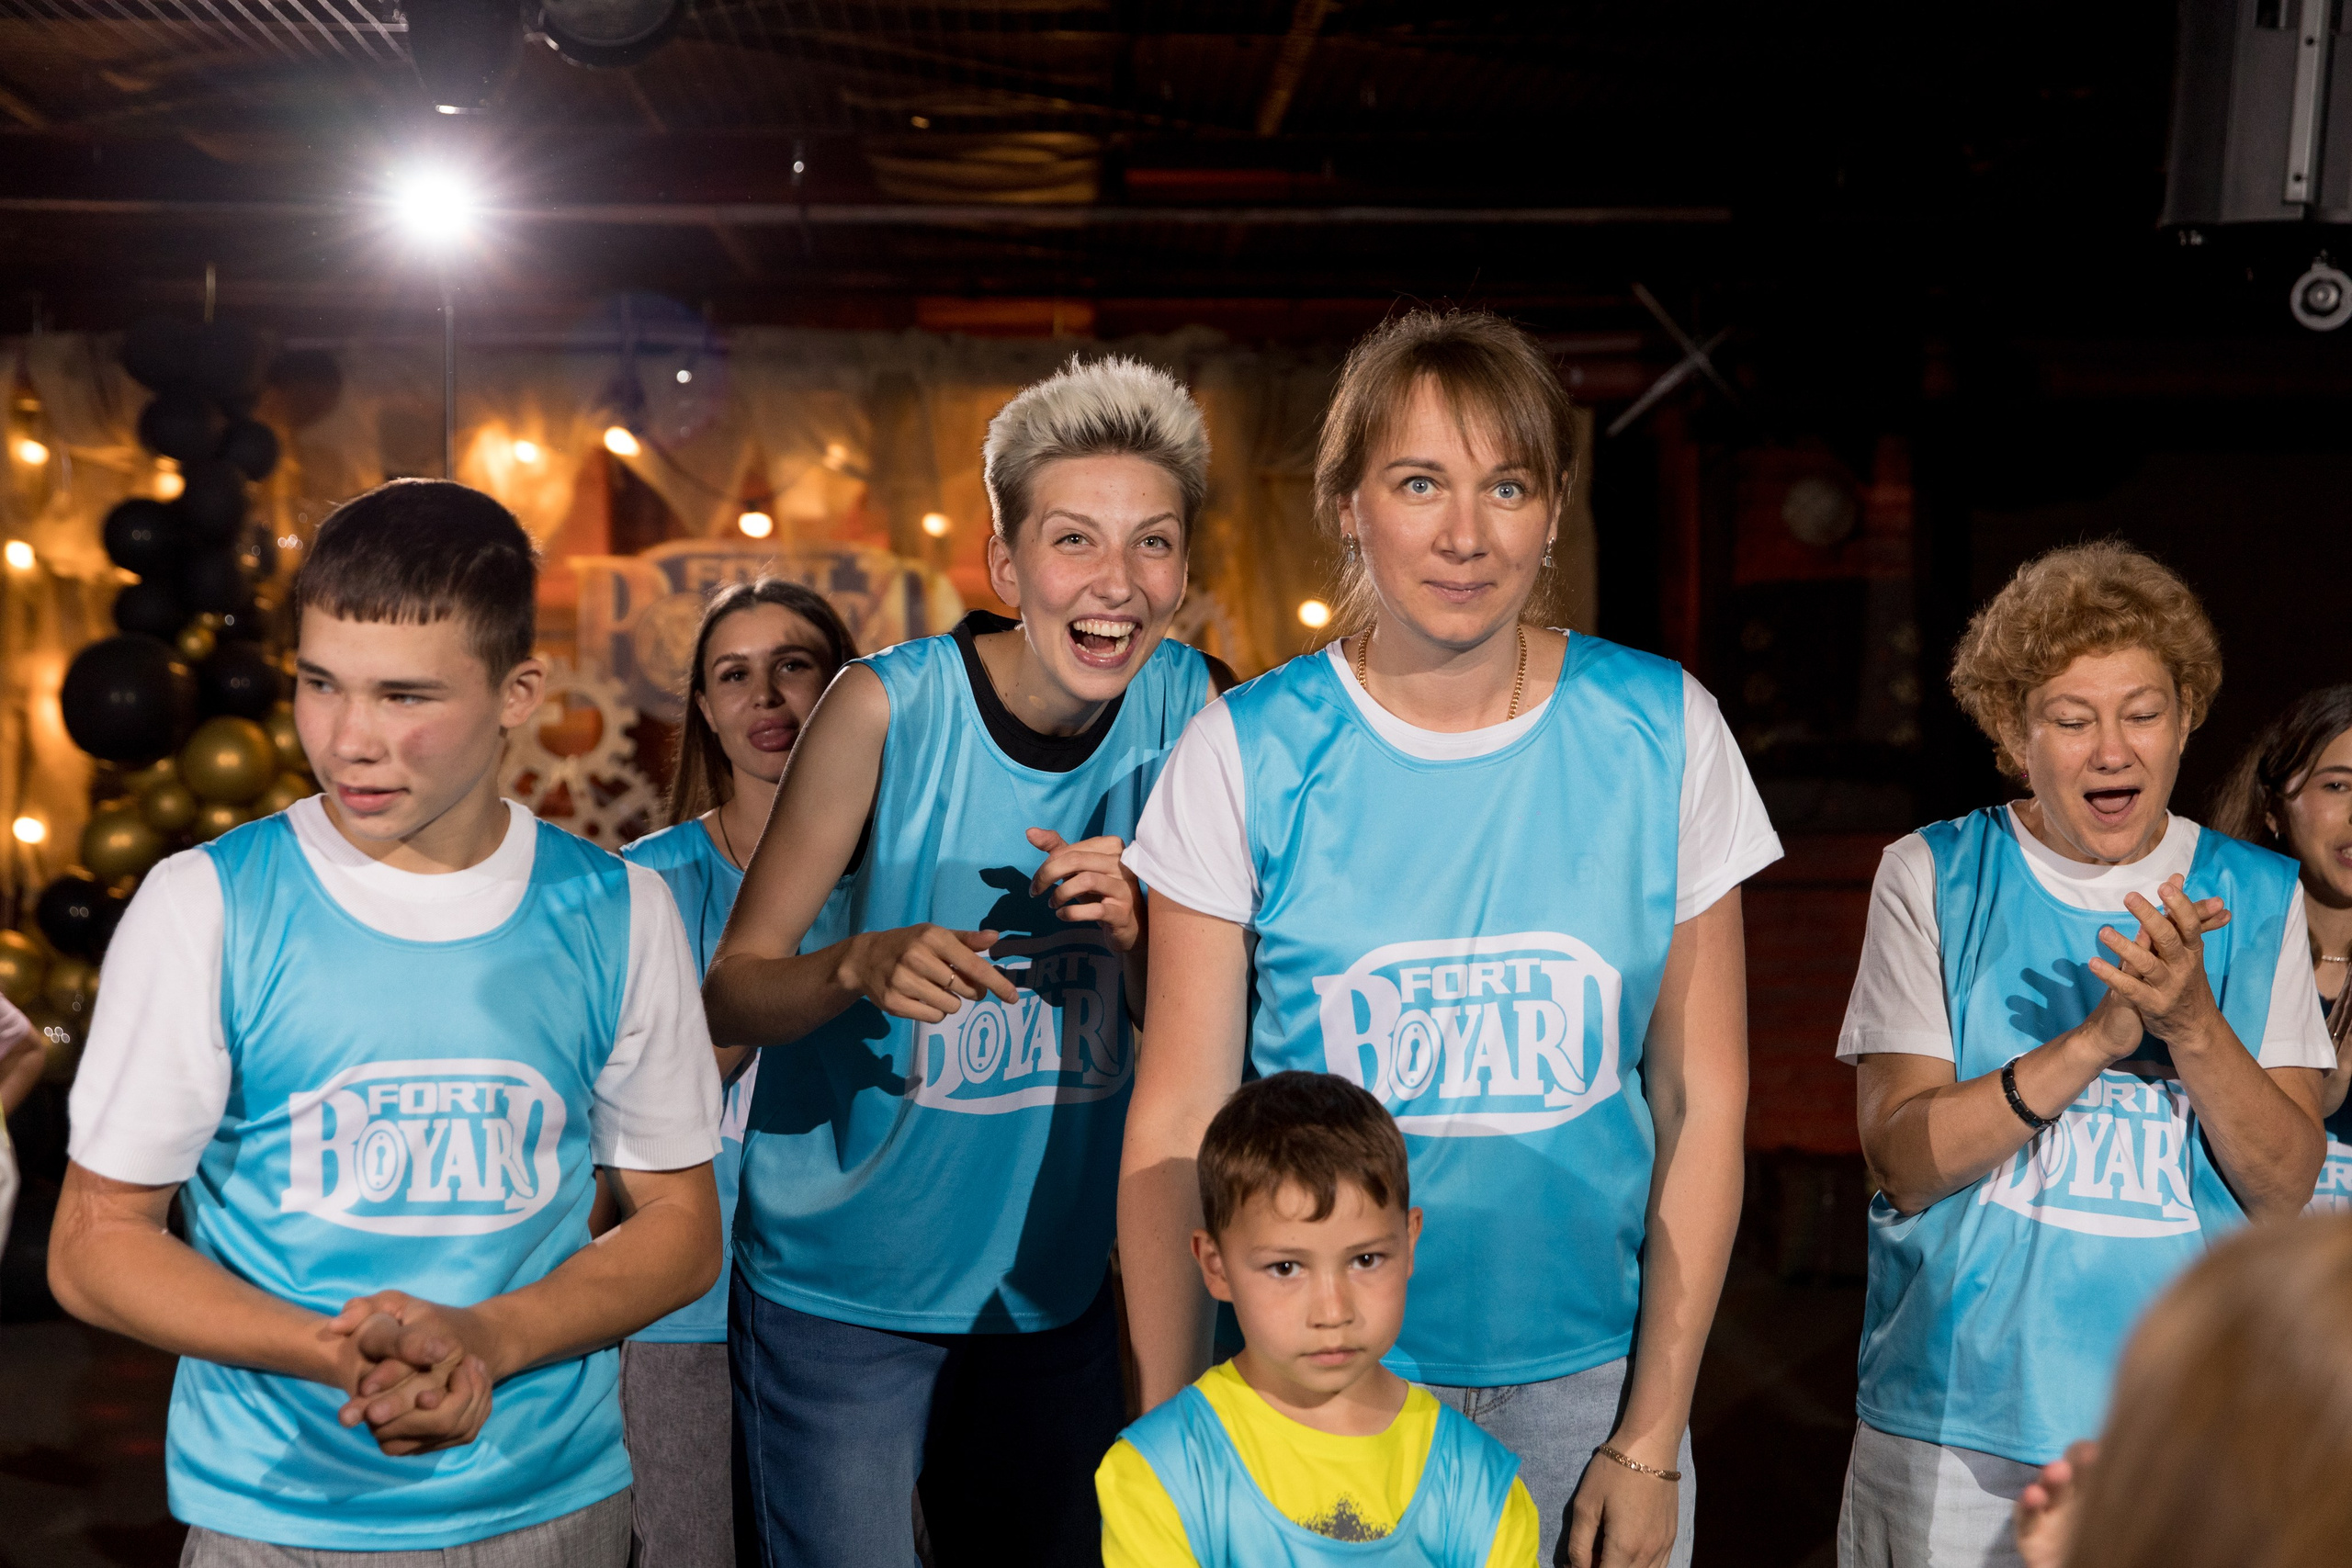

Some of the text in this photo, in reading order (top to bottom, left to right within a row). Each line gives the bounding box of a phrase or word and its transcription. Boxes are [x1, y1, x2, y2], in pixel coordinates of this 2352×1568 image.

[1398, 957, 1541, 1003] FORT
[1312, 960, 1623, 1108] BOYARD
[368, 1081, 505, 1116] FORT
[281, 1086, 567, 1214] BOYARD
